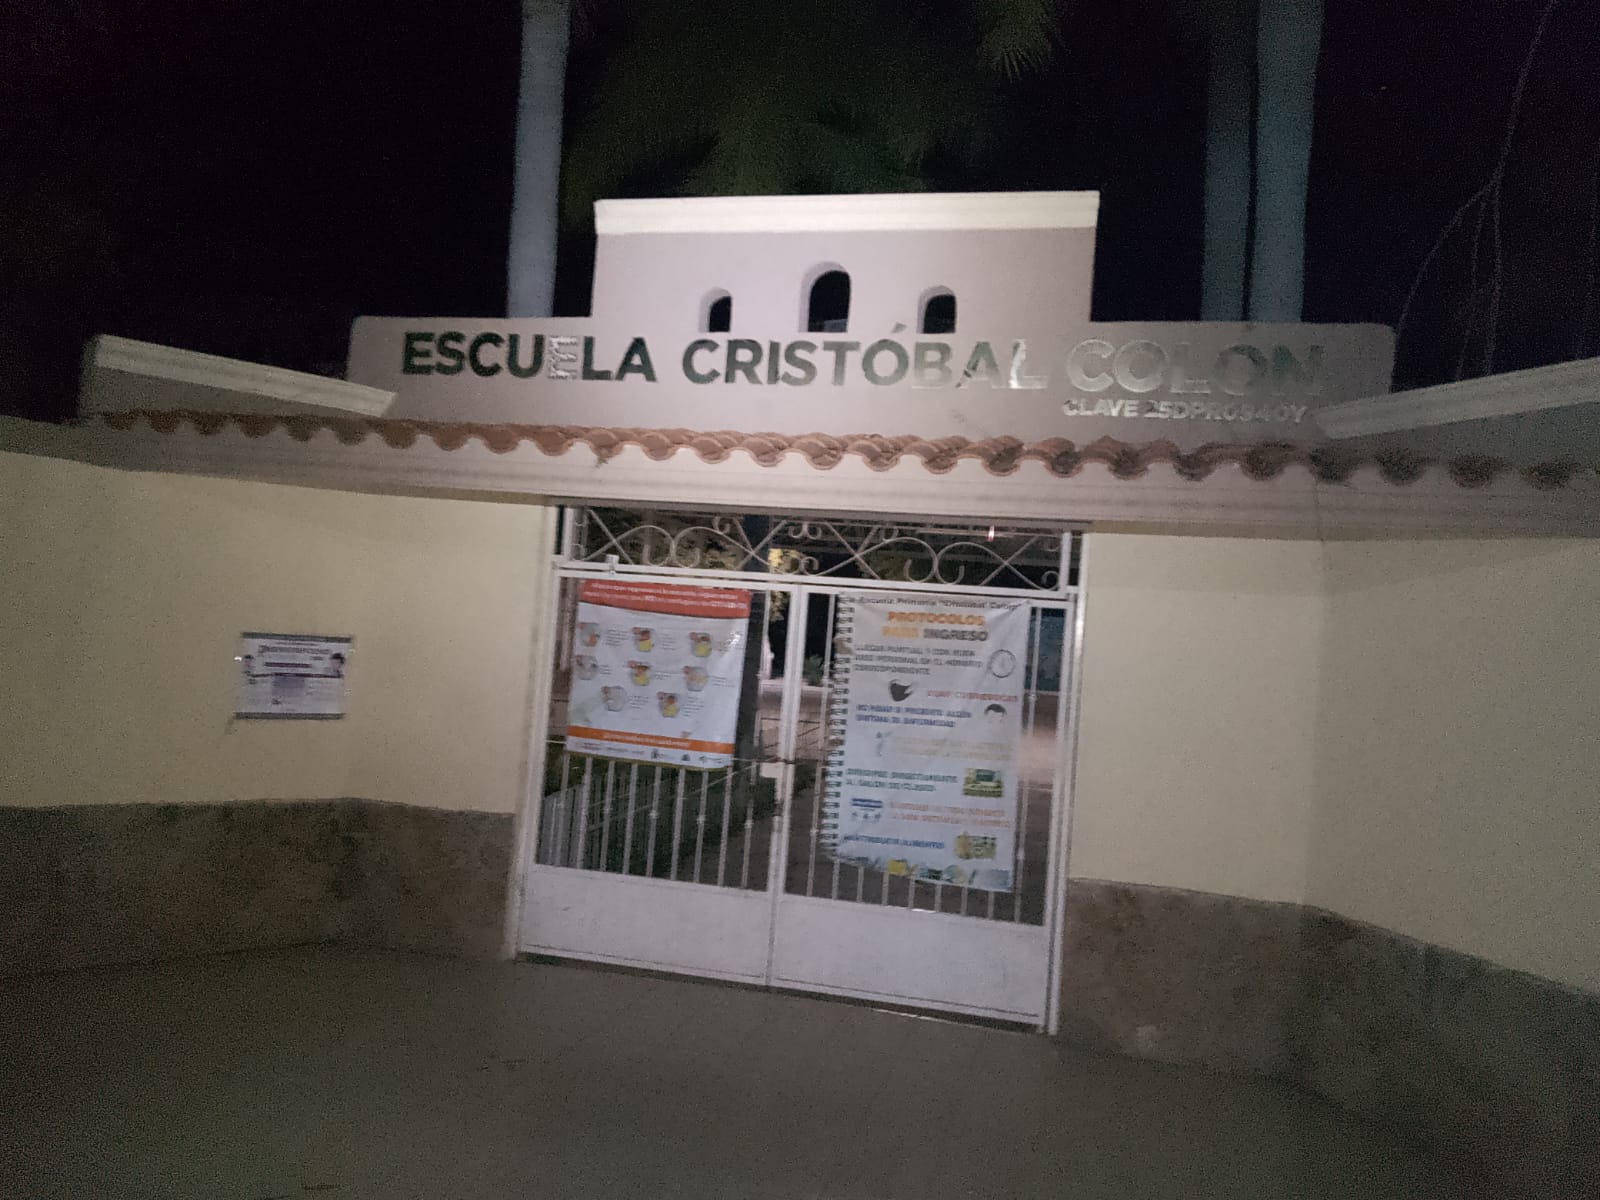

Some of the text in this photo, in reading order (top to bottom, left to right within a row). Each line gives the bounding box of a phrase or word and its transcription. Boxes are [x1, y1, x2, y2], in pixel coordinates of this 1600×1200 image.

[402, 331, 658, 383] ESCUELA
[682, 323, 1048, 389] CRISTÓBAL
[1063, 399, 1139, 418] CLAVE
[887, 611, 986, 626] PROTOCOLOS
[923, 628, 989, 642] INGRESO
